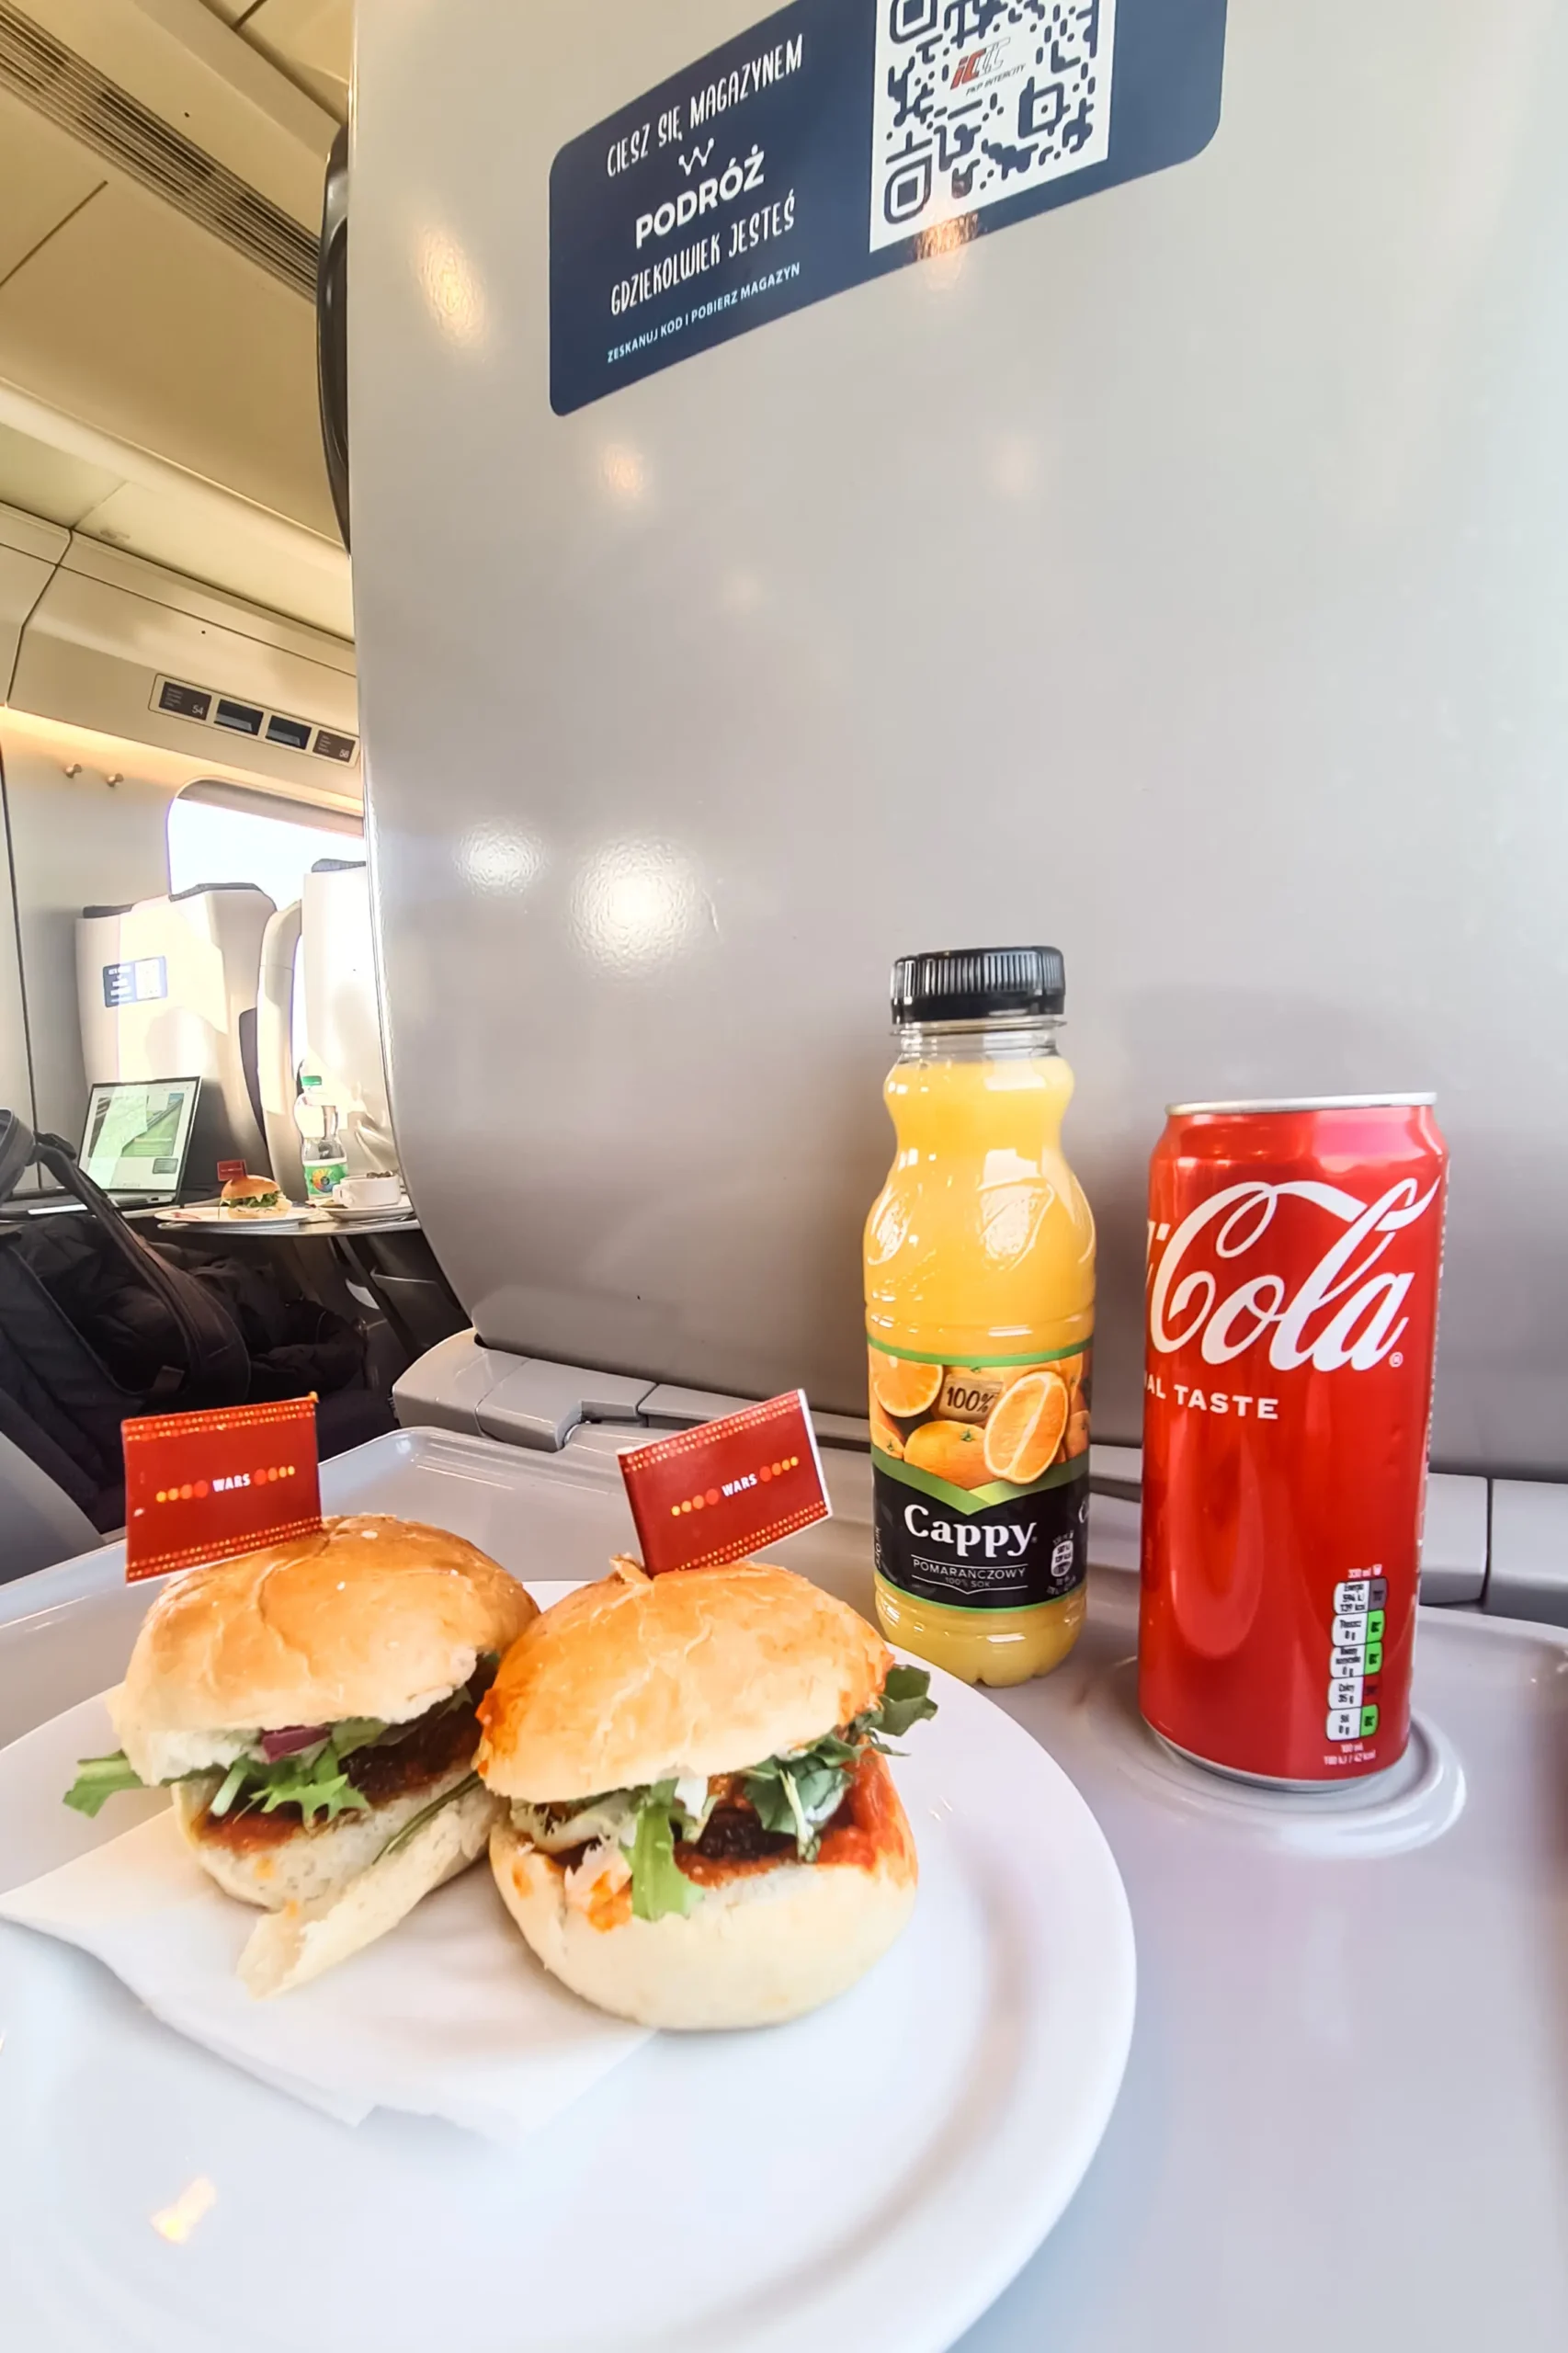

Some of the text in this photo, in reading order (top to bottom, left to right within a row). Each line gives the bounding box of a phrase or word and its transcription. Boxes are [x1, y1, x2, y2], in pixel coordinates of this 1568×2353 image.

[984, 63, 1026, 87] INTERCITY
[607, 33, 804, 178] CIESZ SIĘ MAGAZYNEM
[635, 143, 765, 249] PODRÓŻ
[610, 188, 796, 316] GDZIEKOLWIEK JESTEŚ
[607, 262, 801, 363] ZESKANUJ KOD I POBIERZ MAGAZYN
[192, 704, 204, 715] 54
[946, 1385, 995, 1414] 100%
[1173, 1384, 1278, 1420] TASTE
[212, 1473, 251, 1493] WARS
[722, 1472, 757, 1497] WARS
[903, 1504, 1037, 1557] Cappy
[913, 1558, 1027, 1581] POMARAŃCZOWY
[971, 1580, 991, 1588] SOK
